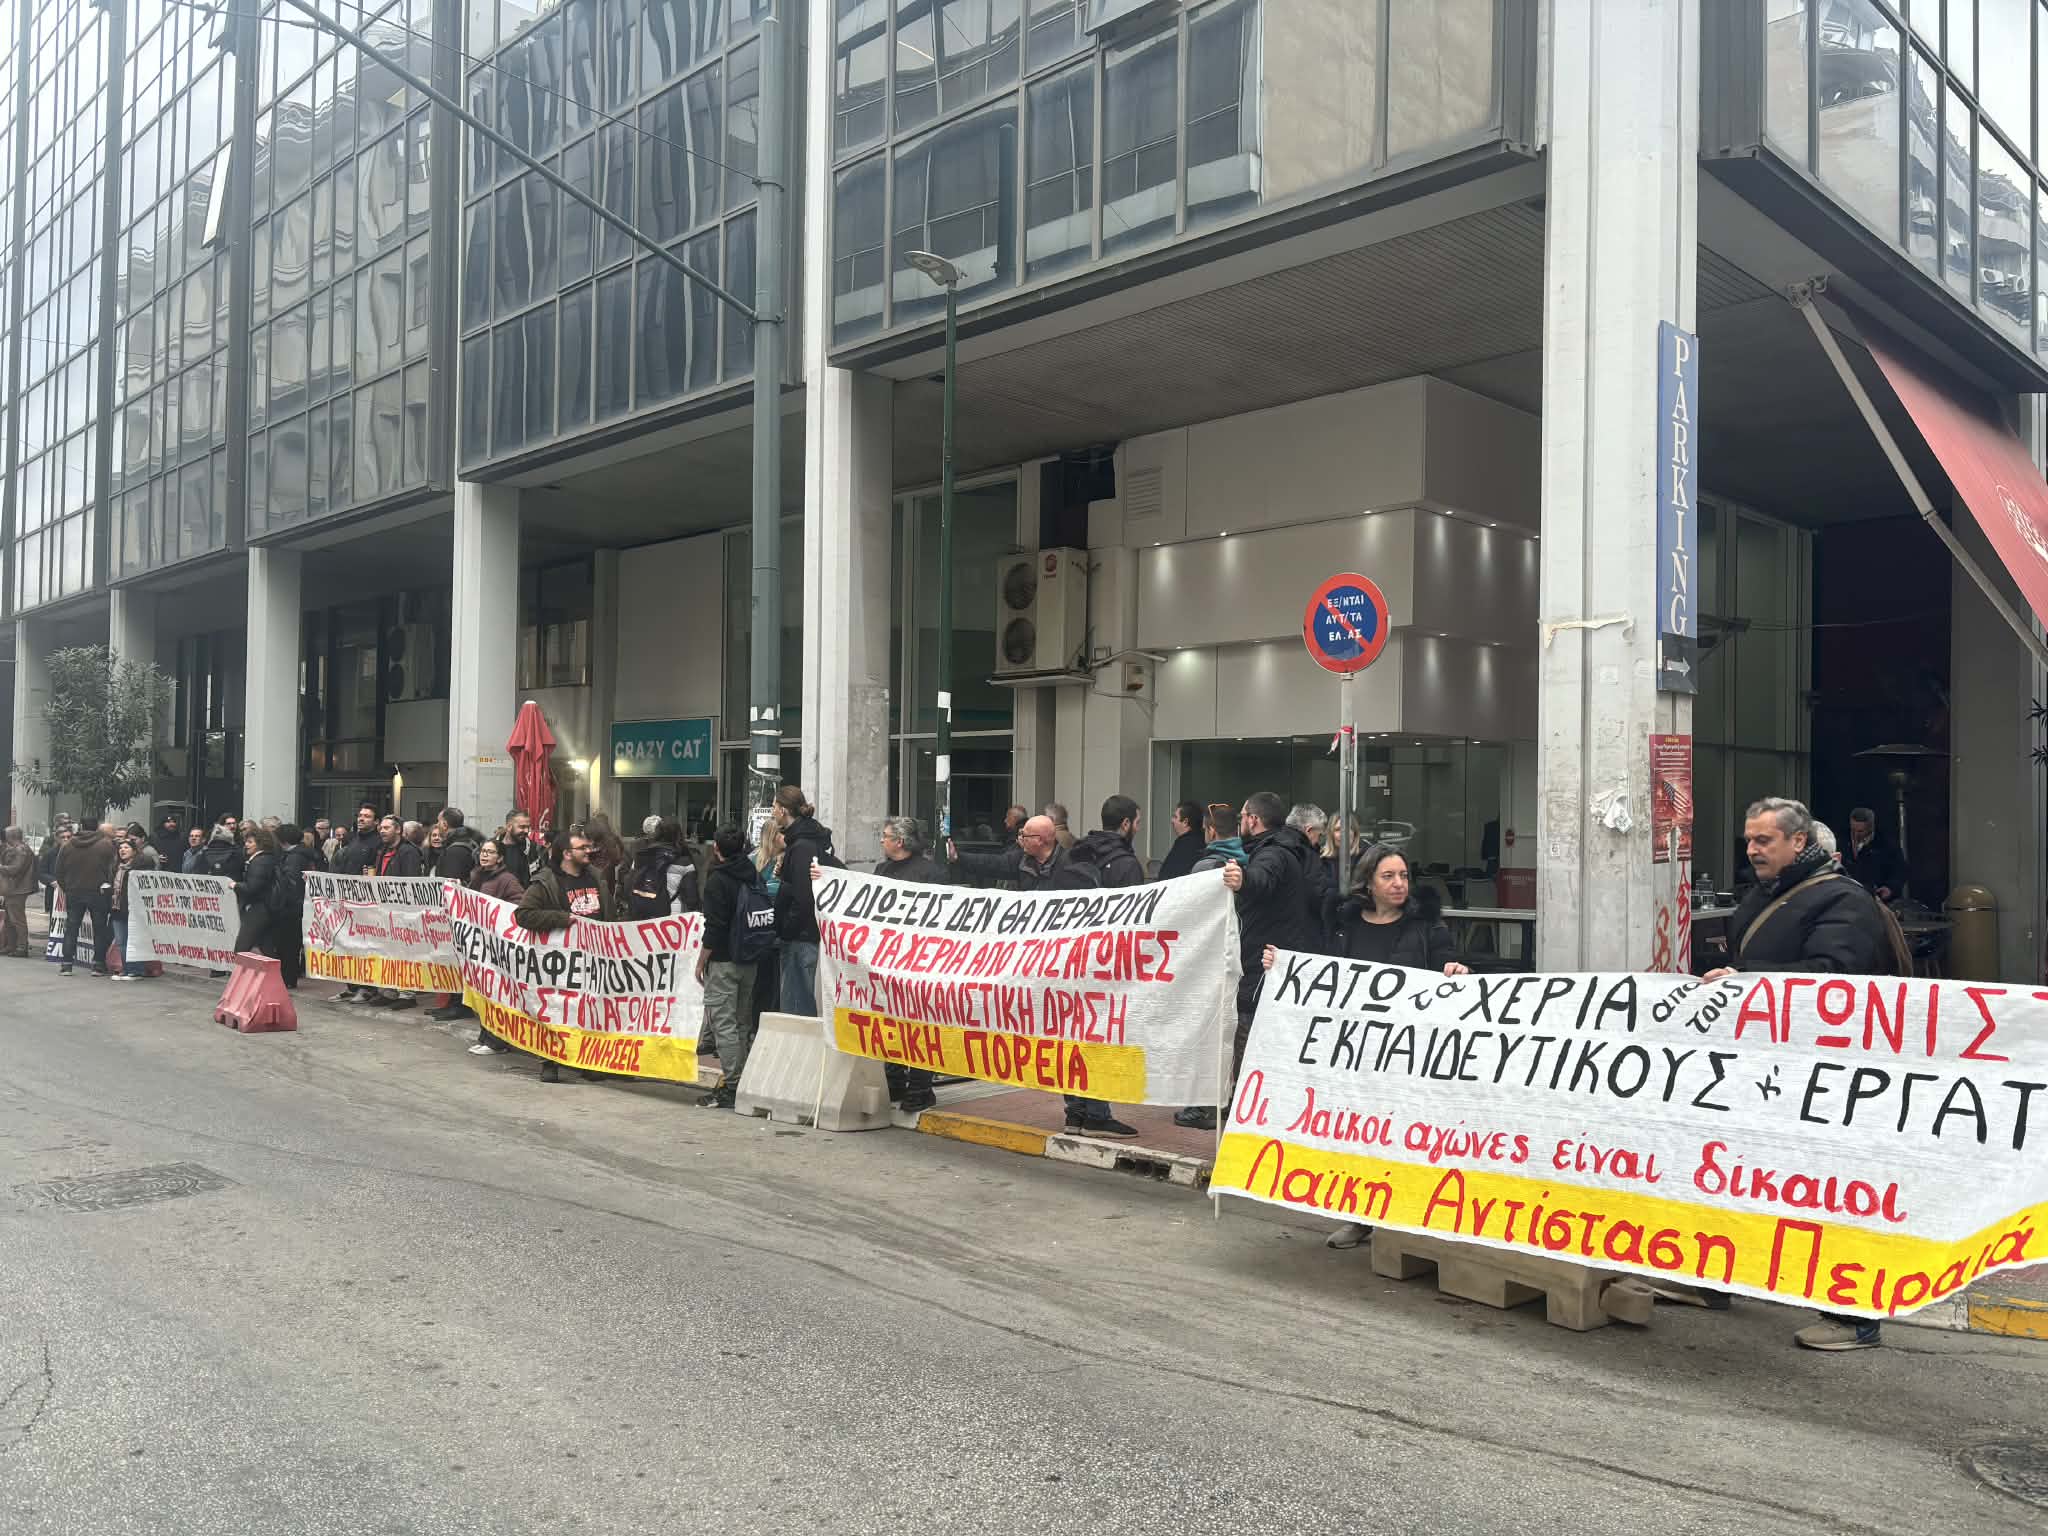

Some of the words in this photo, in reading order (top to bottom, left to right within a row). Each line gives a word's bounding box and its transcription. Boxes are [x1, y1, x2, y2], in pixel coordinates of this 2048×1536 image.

[1671, 336, 1690, 635] PARKING
[615, 740, 664, 759] CRAZY
[672, 739, 702, 759] CAT
[747, 908, 775, 928] VANS
[816, 878, 847, 913] ΟΙ
[844, 884, 953, 929] ΔΙΩΞΕΙΣ
[945, 897, 999, 934] ΔΕΝ
[998, 899, 1036, 935] ΘΑ
[1031, 886, 1167, 933] ΠΕΡΑΣΟΥΝ
[381, 958, 424, 989] ΚΙΝΗΣΕΙΣ
[818, 920, 869, 964] ΚΑΤΩ
[870, 928, 904, 969] ΤΑ
[894, 934, 971, 975] ΧΕΡΙΑ
[965, 941, 1017, 977] ΑΠΟ
[1012, 937, 1071, 978] ΤΟΥΣ
[1064, 931, 1179, 982] ΑΓΩΝΕΣ
[603, 996, 677, 1034] ΑΓΩΝΕΣ
[869, 973, 1034, 1034] ΣΥΝΔΙΚΑΛΙΣΤΙΚΗ
[1043, 987, 1127, 1044] ΔΡΑΣΗ
[1274, 954, 1407, 1012] ΚΑΤΩ
[1408, 980, 1467, 1011] τα
[1459, 975, 1637, 1032] ΧΕΡΙΑ
[1685, 980, 1744, 1033] τους
[485, 1002, 570, 1060] ΑΓΩΝΙΣΤΙΚΕΣ
[576, 1035, 645, 1072] ΚΙΝΗΣΕΙΣ
[849, 1013, 944, 1067] ΤΑΞΙΚΗ
[964, 1031, 1088, 1091] ΠΟΡΕΙΑ
[1298, 1016, 1738, 1111] ΕΚΠΑΙΔΕΥΤΙΚΟΥΣ
[1799, 1062, 2048, 1151] ΕΡΓΑΤ
[1236, 1070, 1268, 1126] Οι
[1286, 1086, 1393, 1146] λαϊκοί
[1404, 1120, 1530, 1163] αγώνες
[1552, 1132, 1664, 1183] είναι
[1694, 1141, 1908, 1223] δίκαιοι
[1245, 1139, 1393, 1219] Λαϊκή
[1423, 1168, 1736, 1284] Αντίσταση
[1767, 1216, 2035, 1318] Πειραιά
